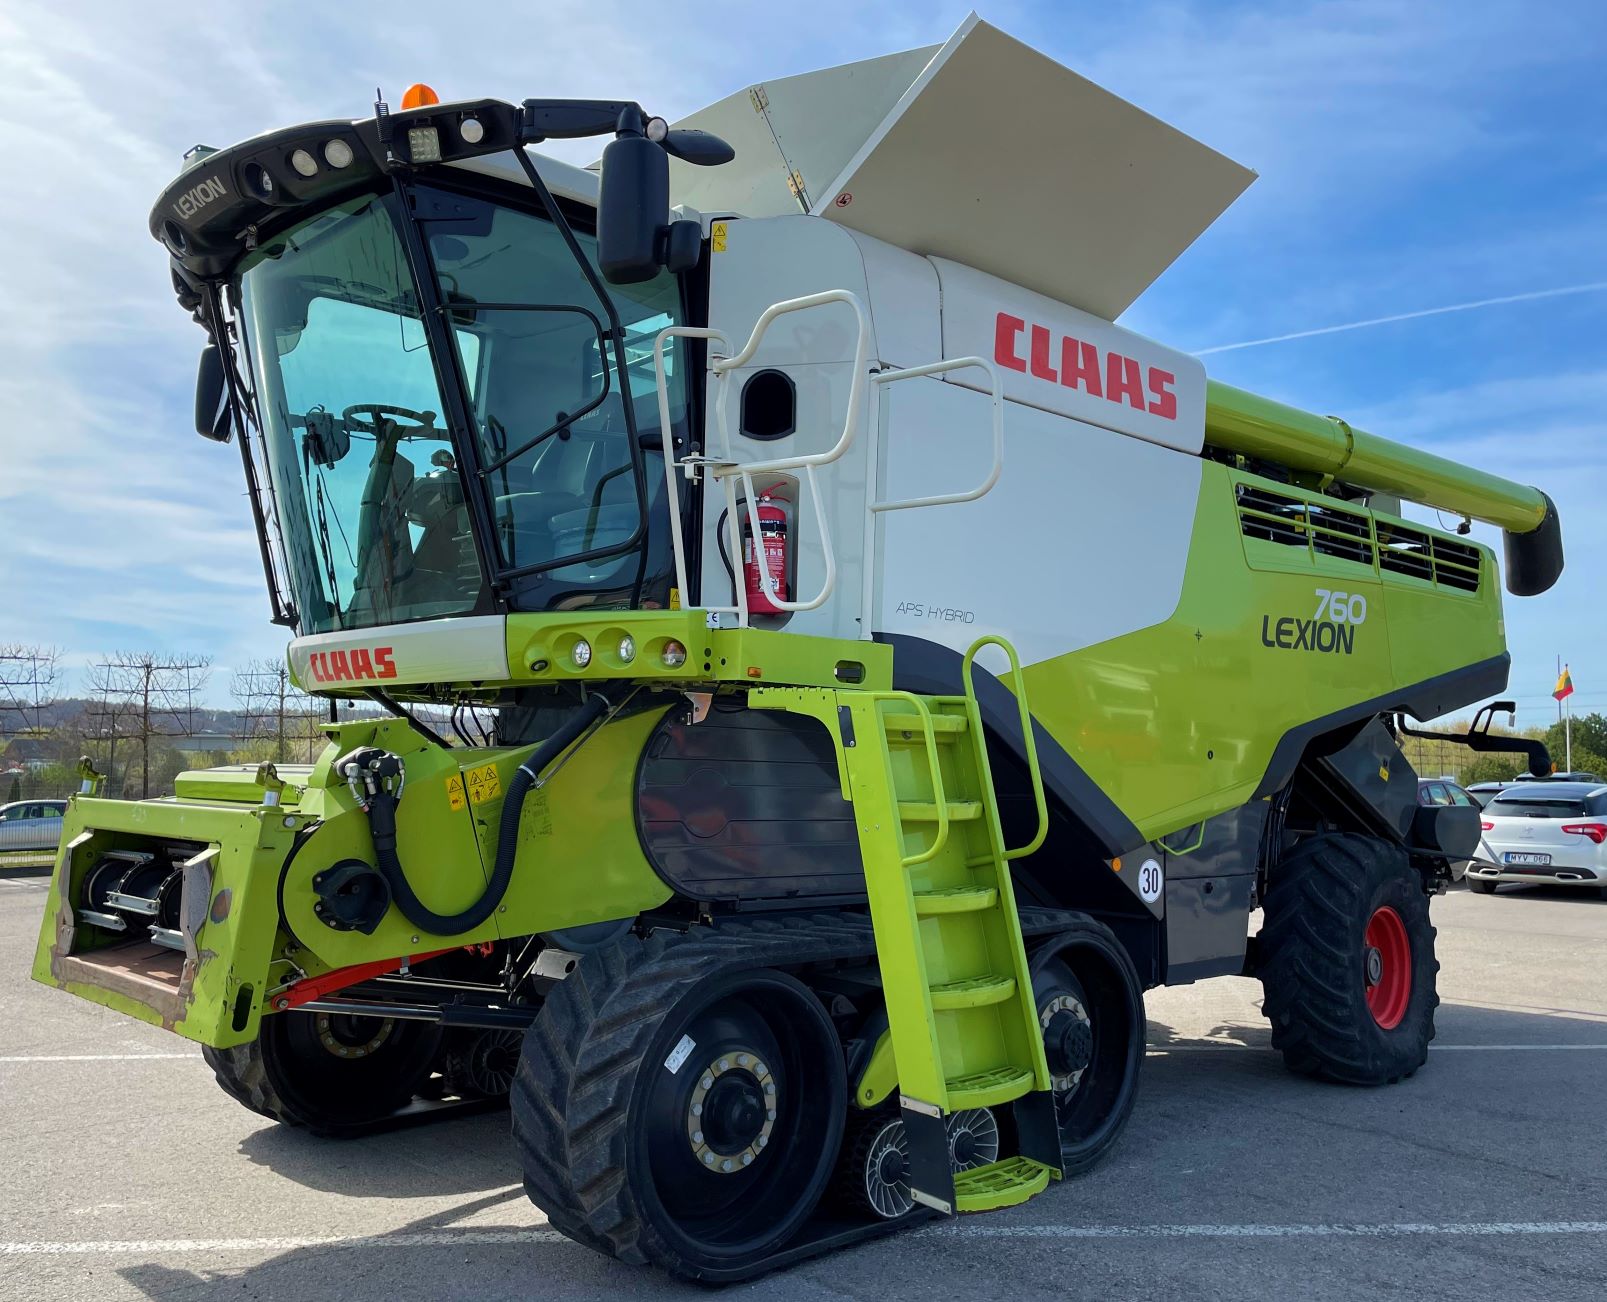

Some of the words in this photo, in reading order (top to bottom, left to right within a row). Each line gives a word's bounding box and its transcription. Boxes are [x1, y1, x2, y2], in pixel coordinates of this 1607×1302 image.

[173, 175, 227, 220] LEXION
[994, 311, 1177, 421] CLAAS
[895, 601, 924, 617] APS
[927, 605, 975, 624] HYBRID
[1313, 588, 1367, 625] 760
[1261, 614, 1355, 655] LEXION
[309, 646, 398, 683] CLAAS
[1142, 867, 1159, 894] 30
